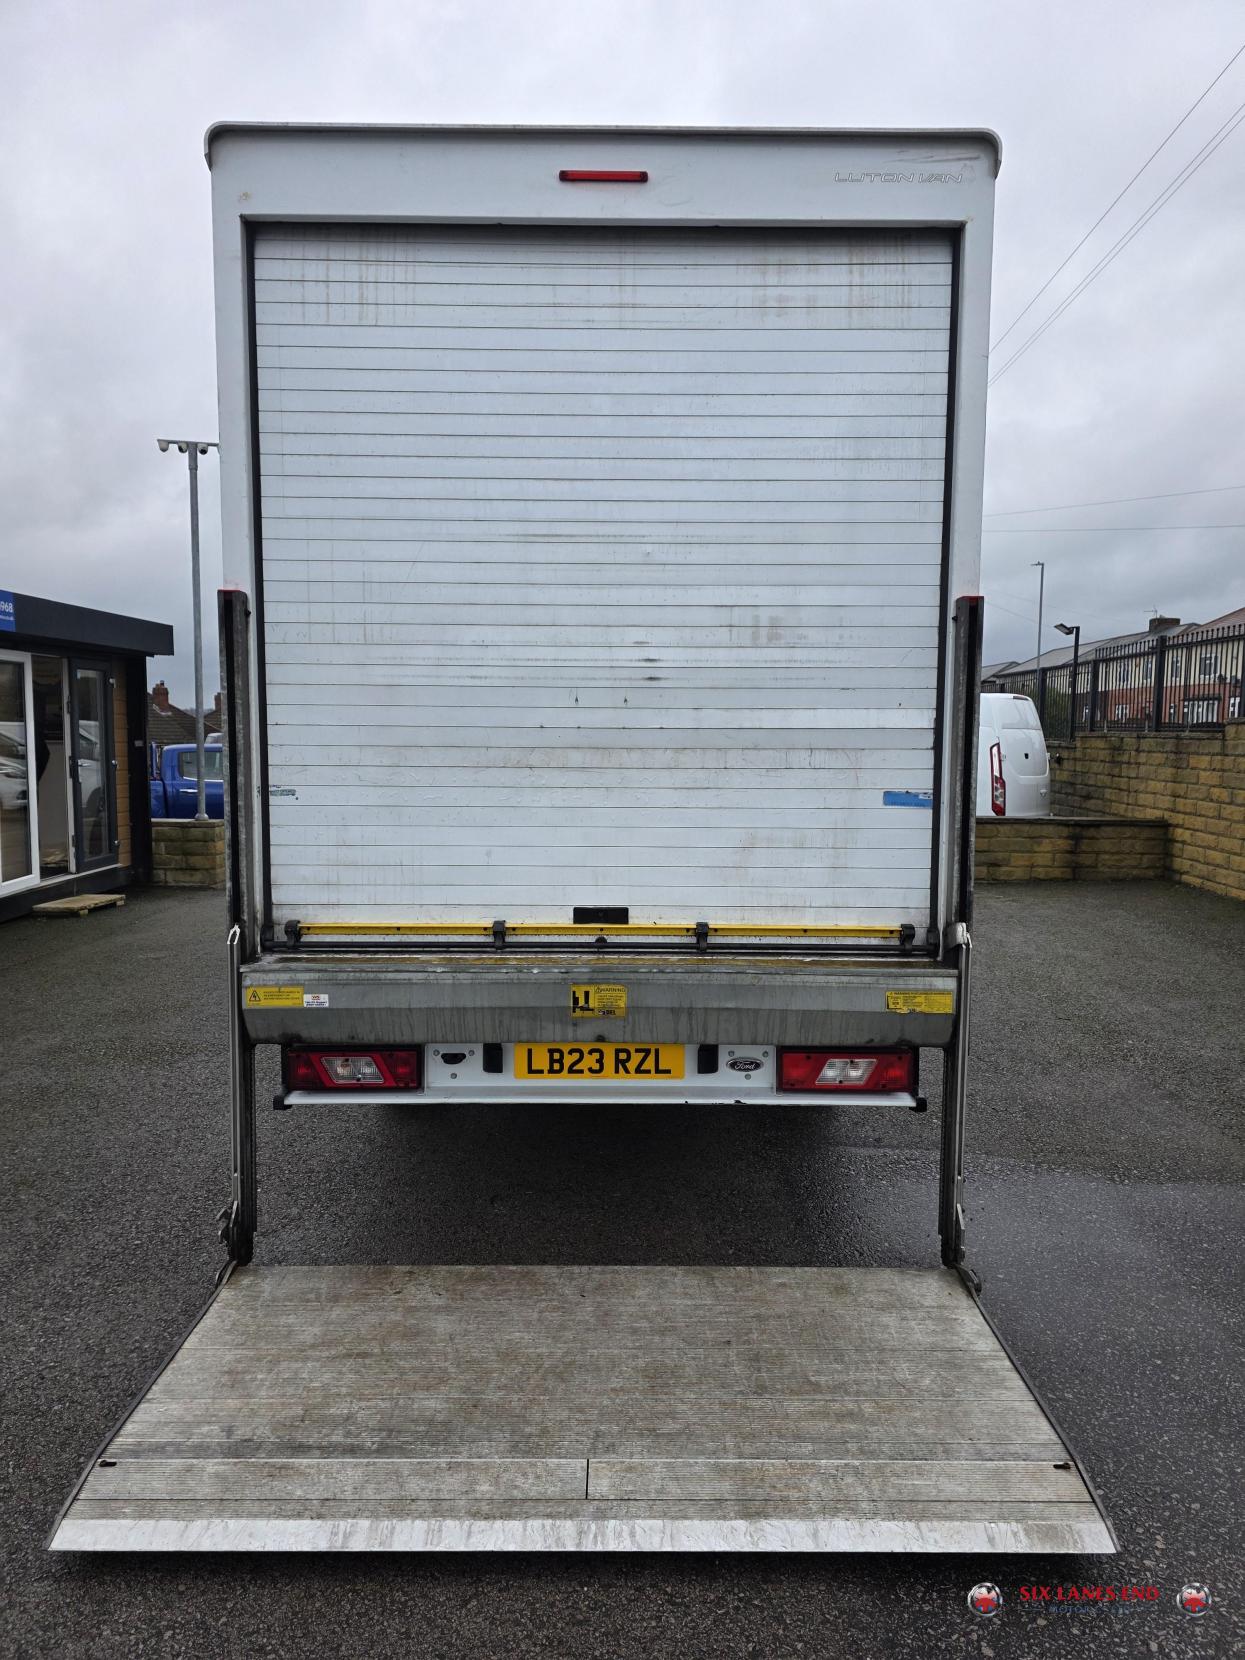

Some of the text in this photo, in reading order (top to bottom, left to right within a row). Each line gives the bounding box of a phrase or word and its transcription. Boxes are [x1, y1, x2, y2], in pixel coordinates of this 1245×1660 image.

[834, 172, 964, 184] LUTON VAN
[0, 601, 14, 613] 968
[527, 1048, 672, 1075] LB23 RZL
[734, 1061, 756, 1071] Ford
